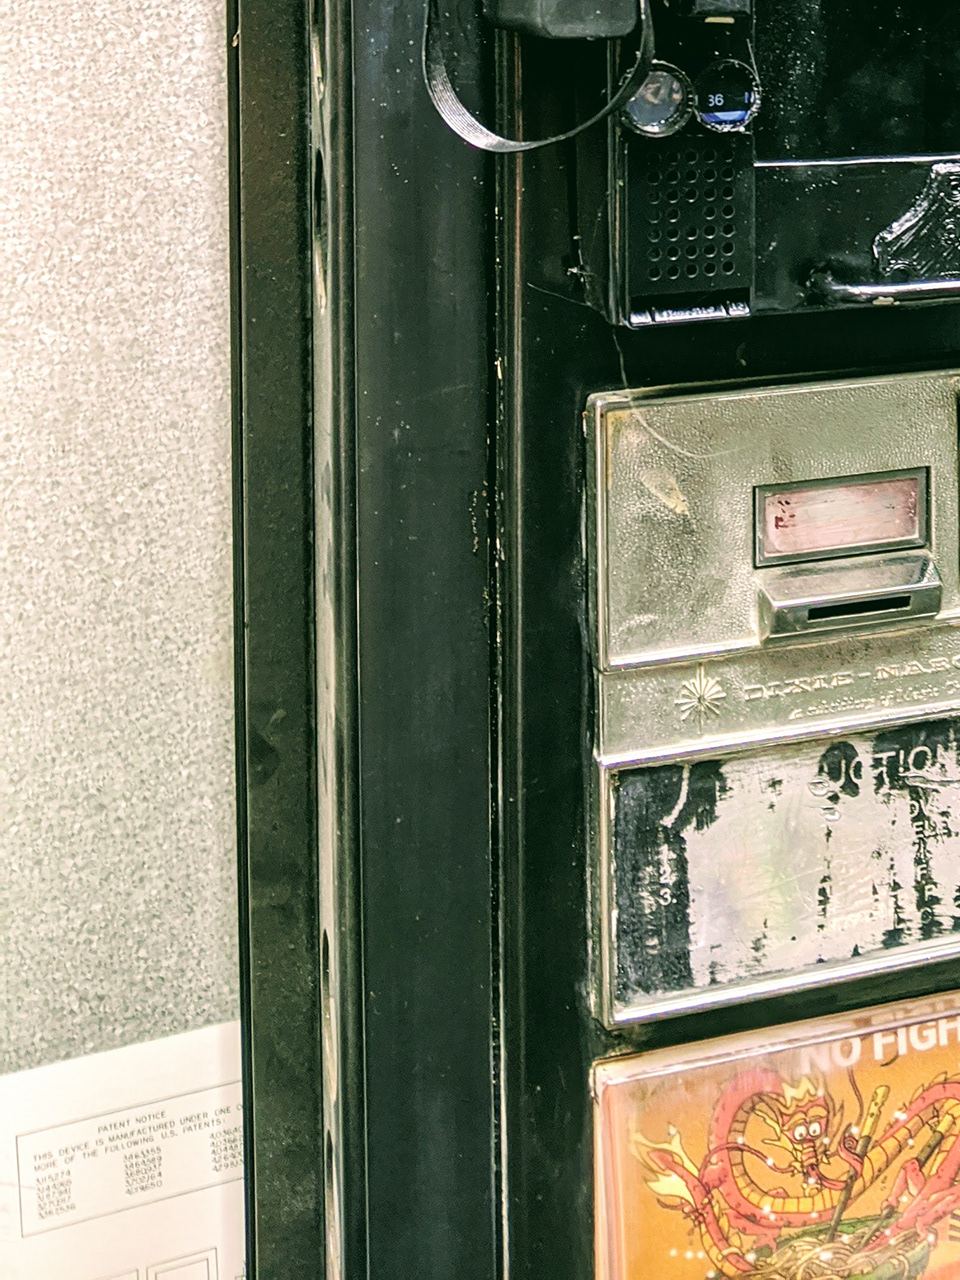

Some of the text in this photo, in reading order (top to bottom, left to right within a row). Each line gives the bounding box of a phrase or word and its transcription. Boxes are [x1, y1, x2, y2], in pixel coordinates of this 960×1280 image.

[799, 1036, 862, 1075] NO
[34, 1152, 53, 1162] THIS
[59, 1142, 89, 1156] DEVICE
[95, 1138, 104, 1146] IS
[108, 1120, 176, 1142] MANUFACTURED
[180, 1112, 208, 1126] UNDER
[214, 1106, 231, 1116] ONE
[98, 1110, 166, 1134] PATENT NOTICE
[34, 1160, 58, 1172] MORE
[64, 1154, 75, 1164] OF
[82, 1149, 98, 1159] THE
[104, 1136, 154, 1154] FOLLOWING
[161, 1130, 178, 1140] U.S.
